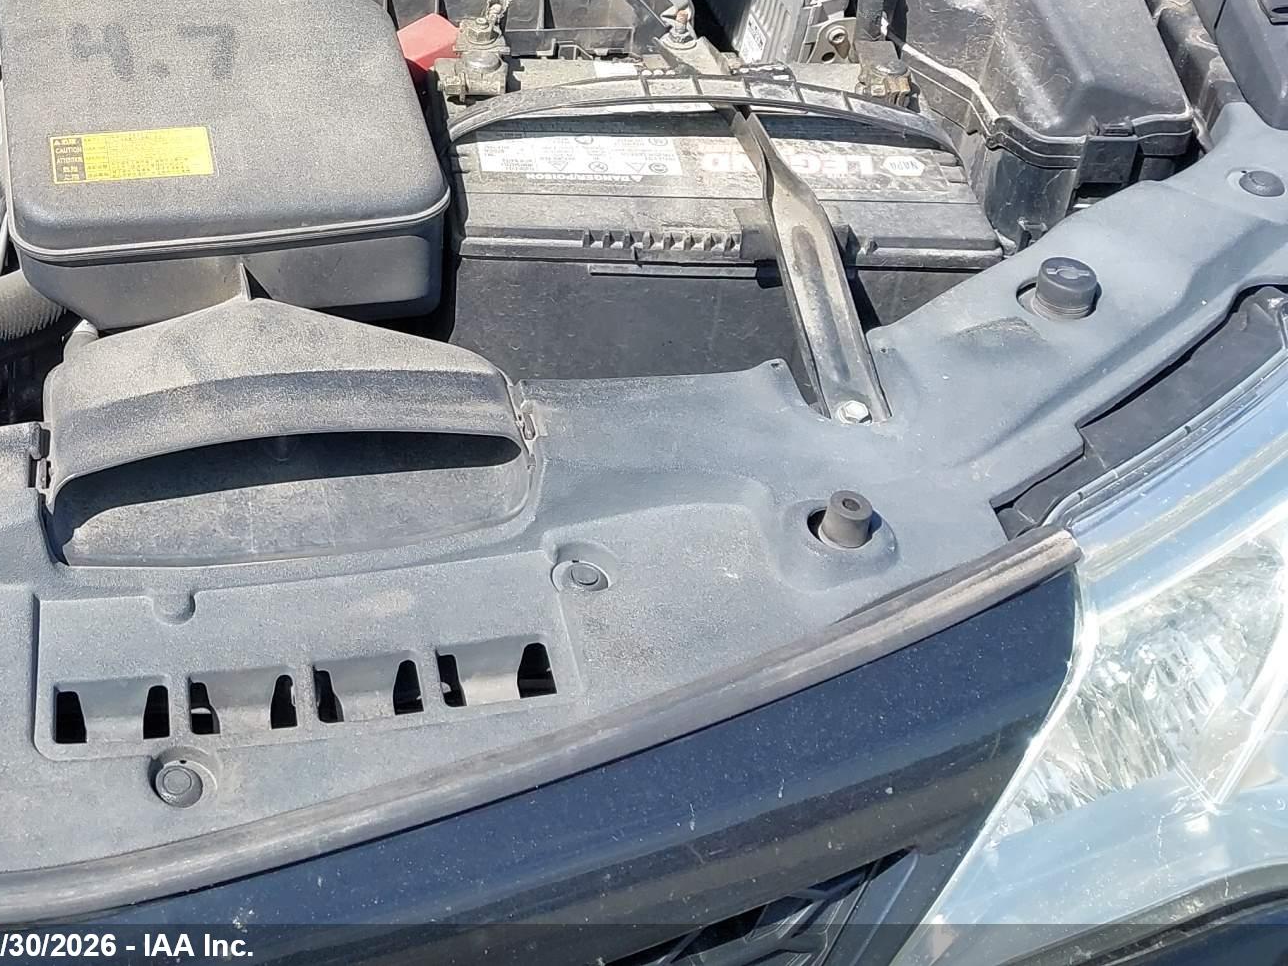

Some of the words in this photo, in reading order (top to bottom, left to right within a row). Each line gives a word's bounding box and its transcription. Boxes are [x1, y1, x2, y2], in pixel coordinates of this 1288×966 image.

[55, 146, 82, 154] CAUTION
[701, 152, 874, 175] LEGND
[888, 160, 919, 170] NAPA
